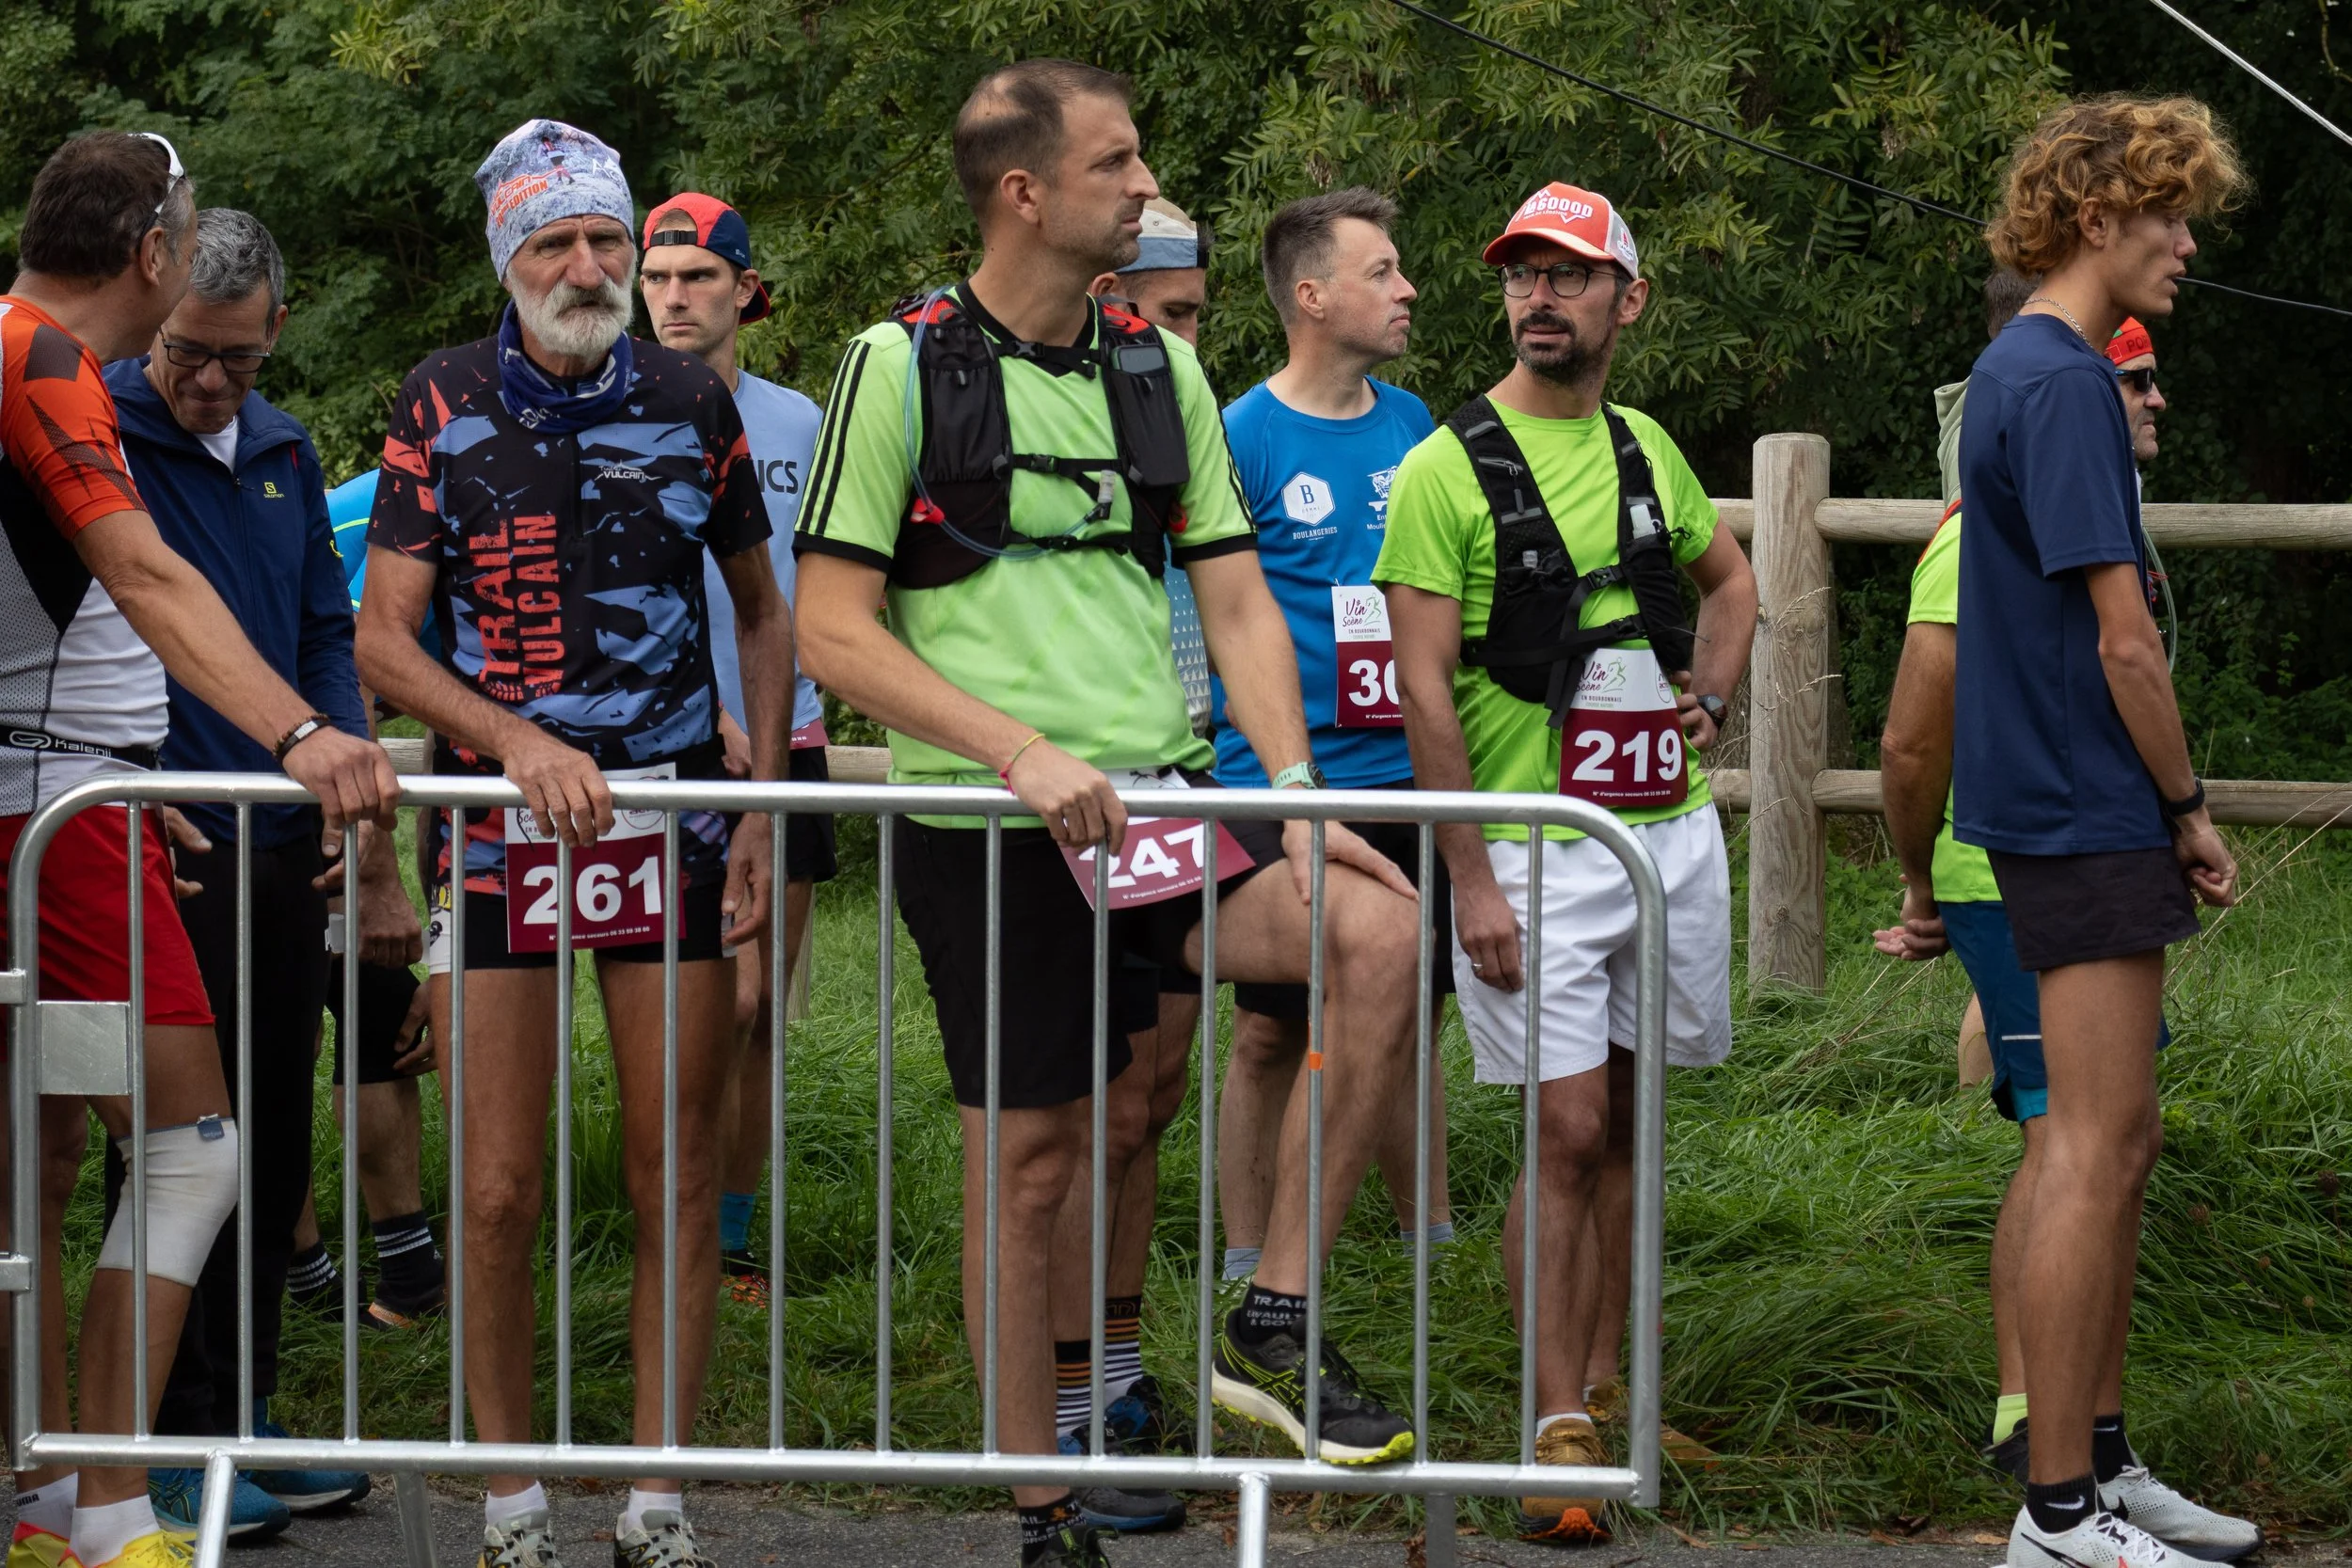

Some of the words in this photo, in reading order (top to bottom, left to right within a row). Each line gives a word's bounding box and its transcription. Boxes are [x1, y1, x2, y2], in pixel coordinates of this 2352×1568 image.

[757, 459, 799, 495] ICS
[1299, 484, 1315, 505] B
[1293, 526, 1338, 541] BOULANGERIES
[469, 518, 520, 685] TRAIL
[513, 515, 565, 687] VULCAIN
[1572, 729, 1682, 782] 219
[1078, 824, 1204, 889] 247
[522, 856, 662, 925] 261
[16, 1493, 40, 1506] UMA
